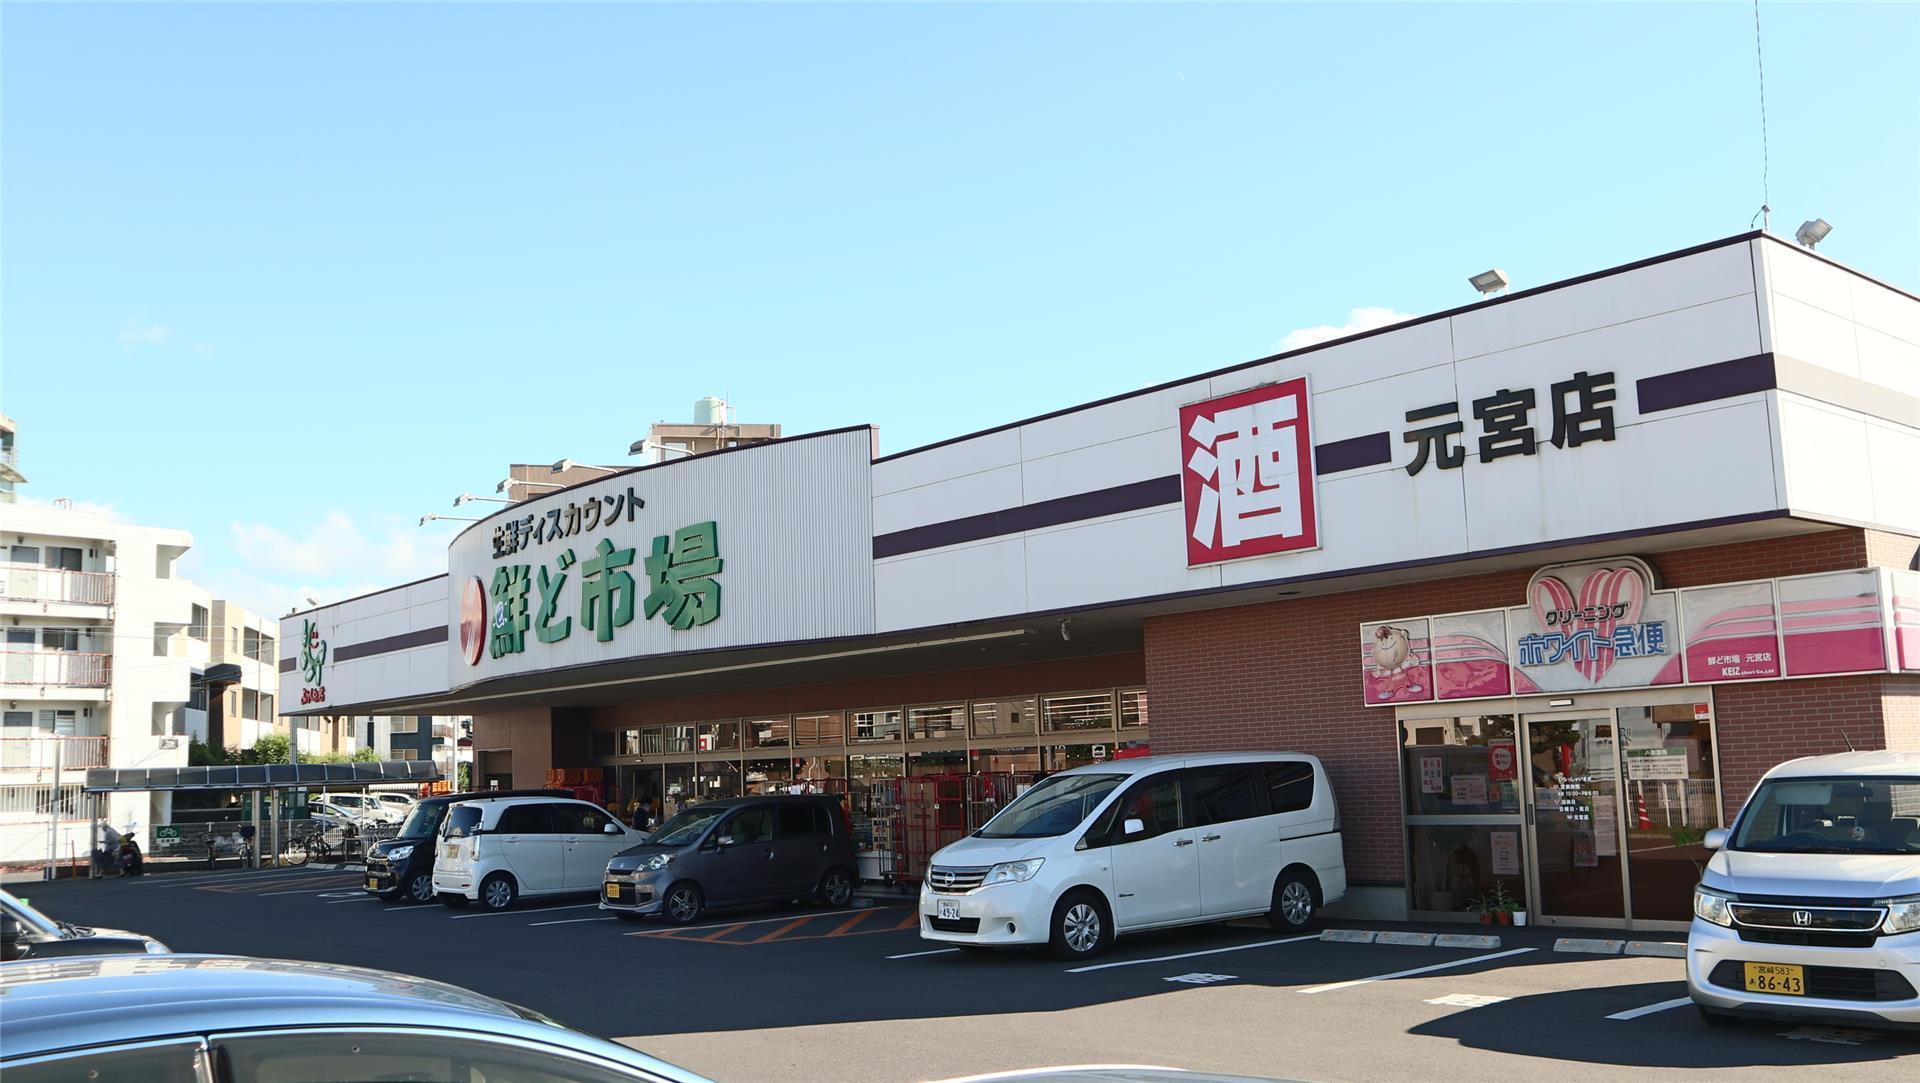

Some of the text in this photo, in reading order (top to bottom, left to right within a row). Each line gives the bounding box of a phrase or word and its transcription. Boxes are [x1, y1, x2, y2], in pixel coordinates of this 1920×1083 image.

[1403, 371, 1616, 477] 元宮店
[1187, 393, 1303, 550] 酒
[492, 487, 645, 559] 生鮮ディスカウント
[488, 520, 724, 660] 鮮ど市場
[1545, 601, 1631, 625] クリーニング
[1518, 621, 1668, 667] ホワイト急便
[1707, 652, 1772, 665] 鮮ど市場 元宮店
[1722, 666, 1741, 677] KEIZ
[1758, 976, 1801, 992] 86-43
